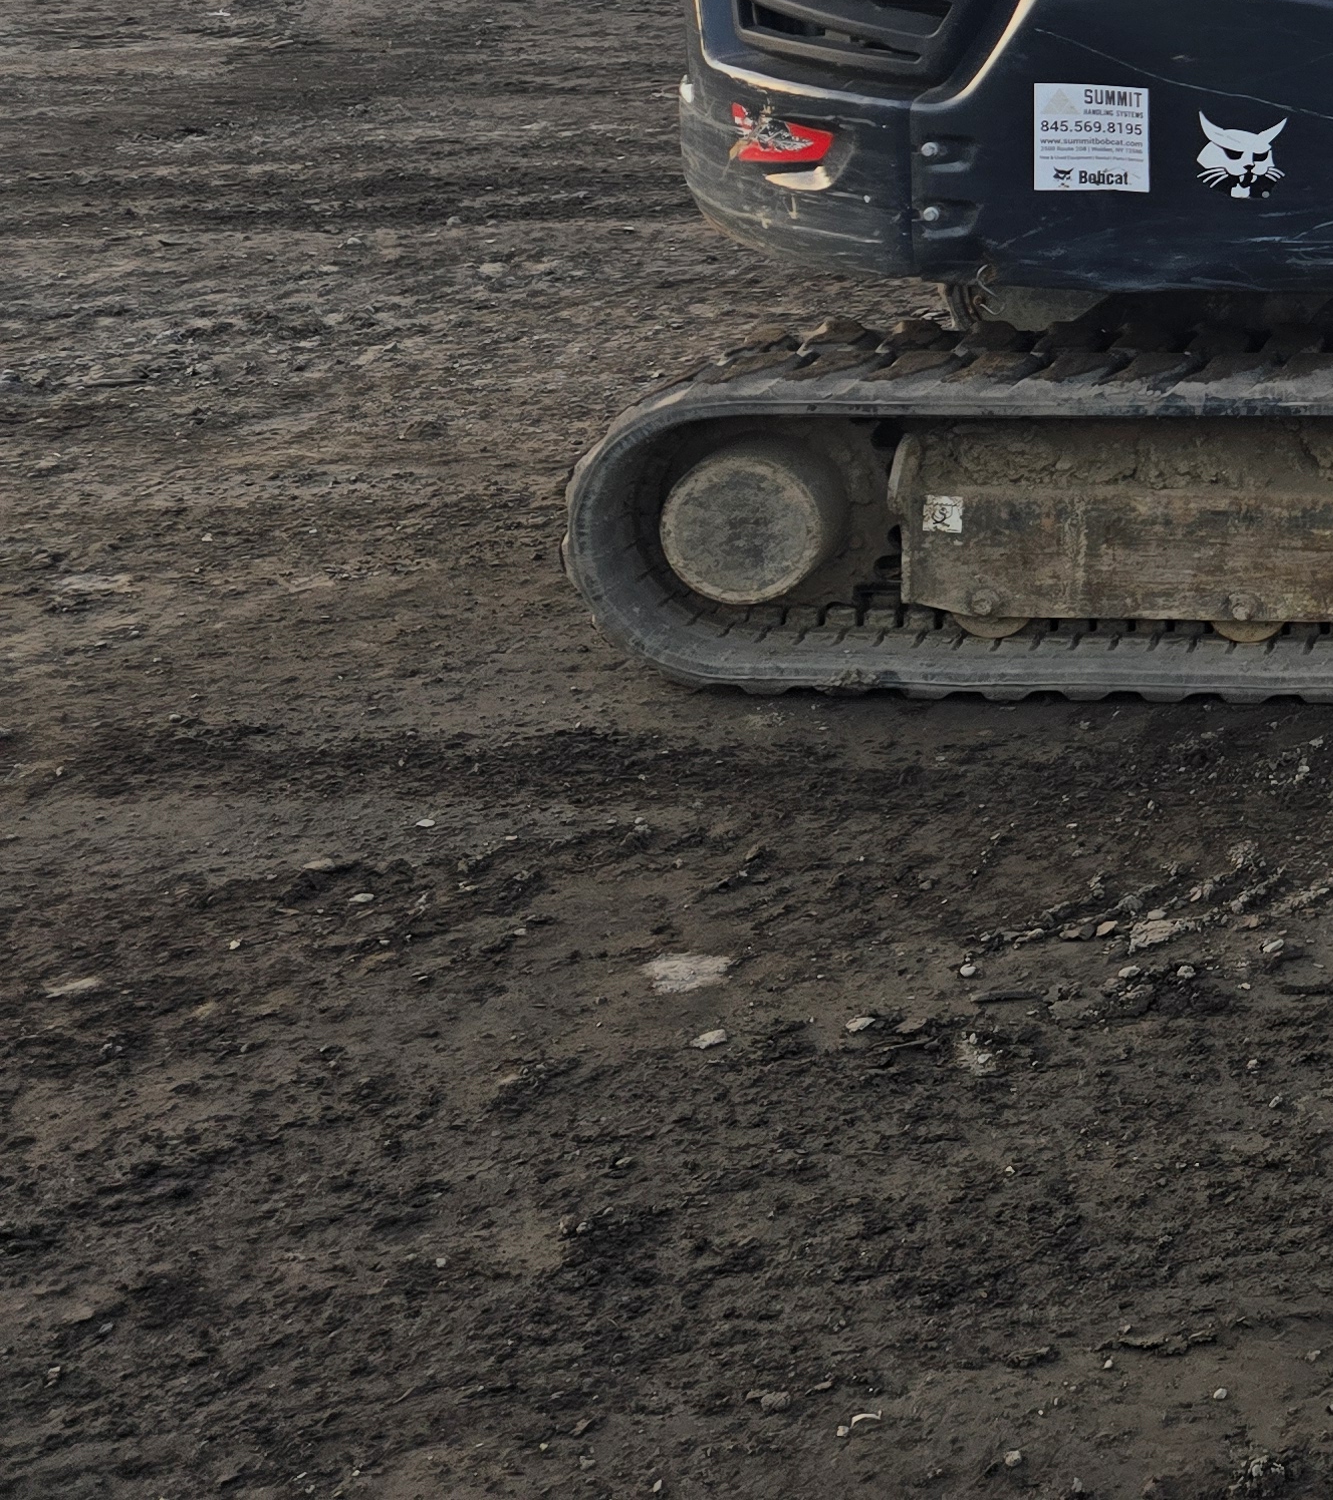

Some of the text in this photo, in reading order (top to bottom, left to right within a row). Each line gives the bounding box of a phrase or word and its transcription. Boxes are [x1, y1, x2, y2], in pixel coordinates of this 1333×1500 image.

[1084, 89, 1142, 107] SUMMIT
[1083, 109, 1144, 119] HANDLING SYSTEMS
[1041, 120, 1142, 135] 845.569.8195
[1040, 137, 1143, 147] www.summitbobcat.com
[1079, 170, 1129, 185] Bobcat
